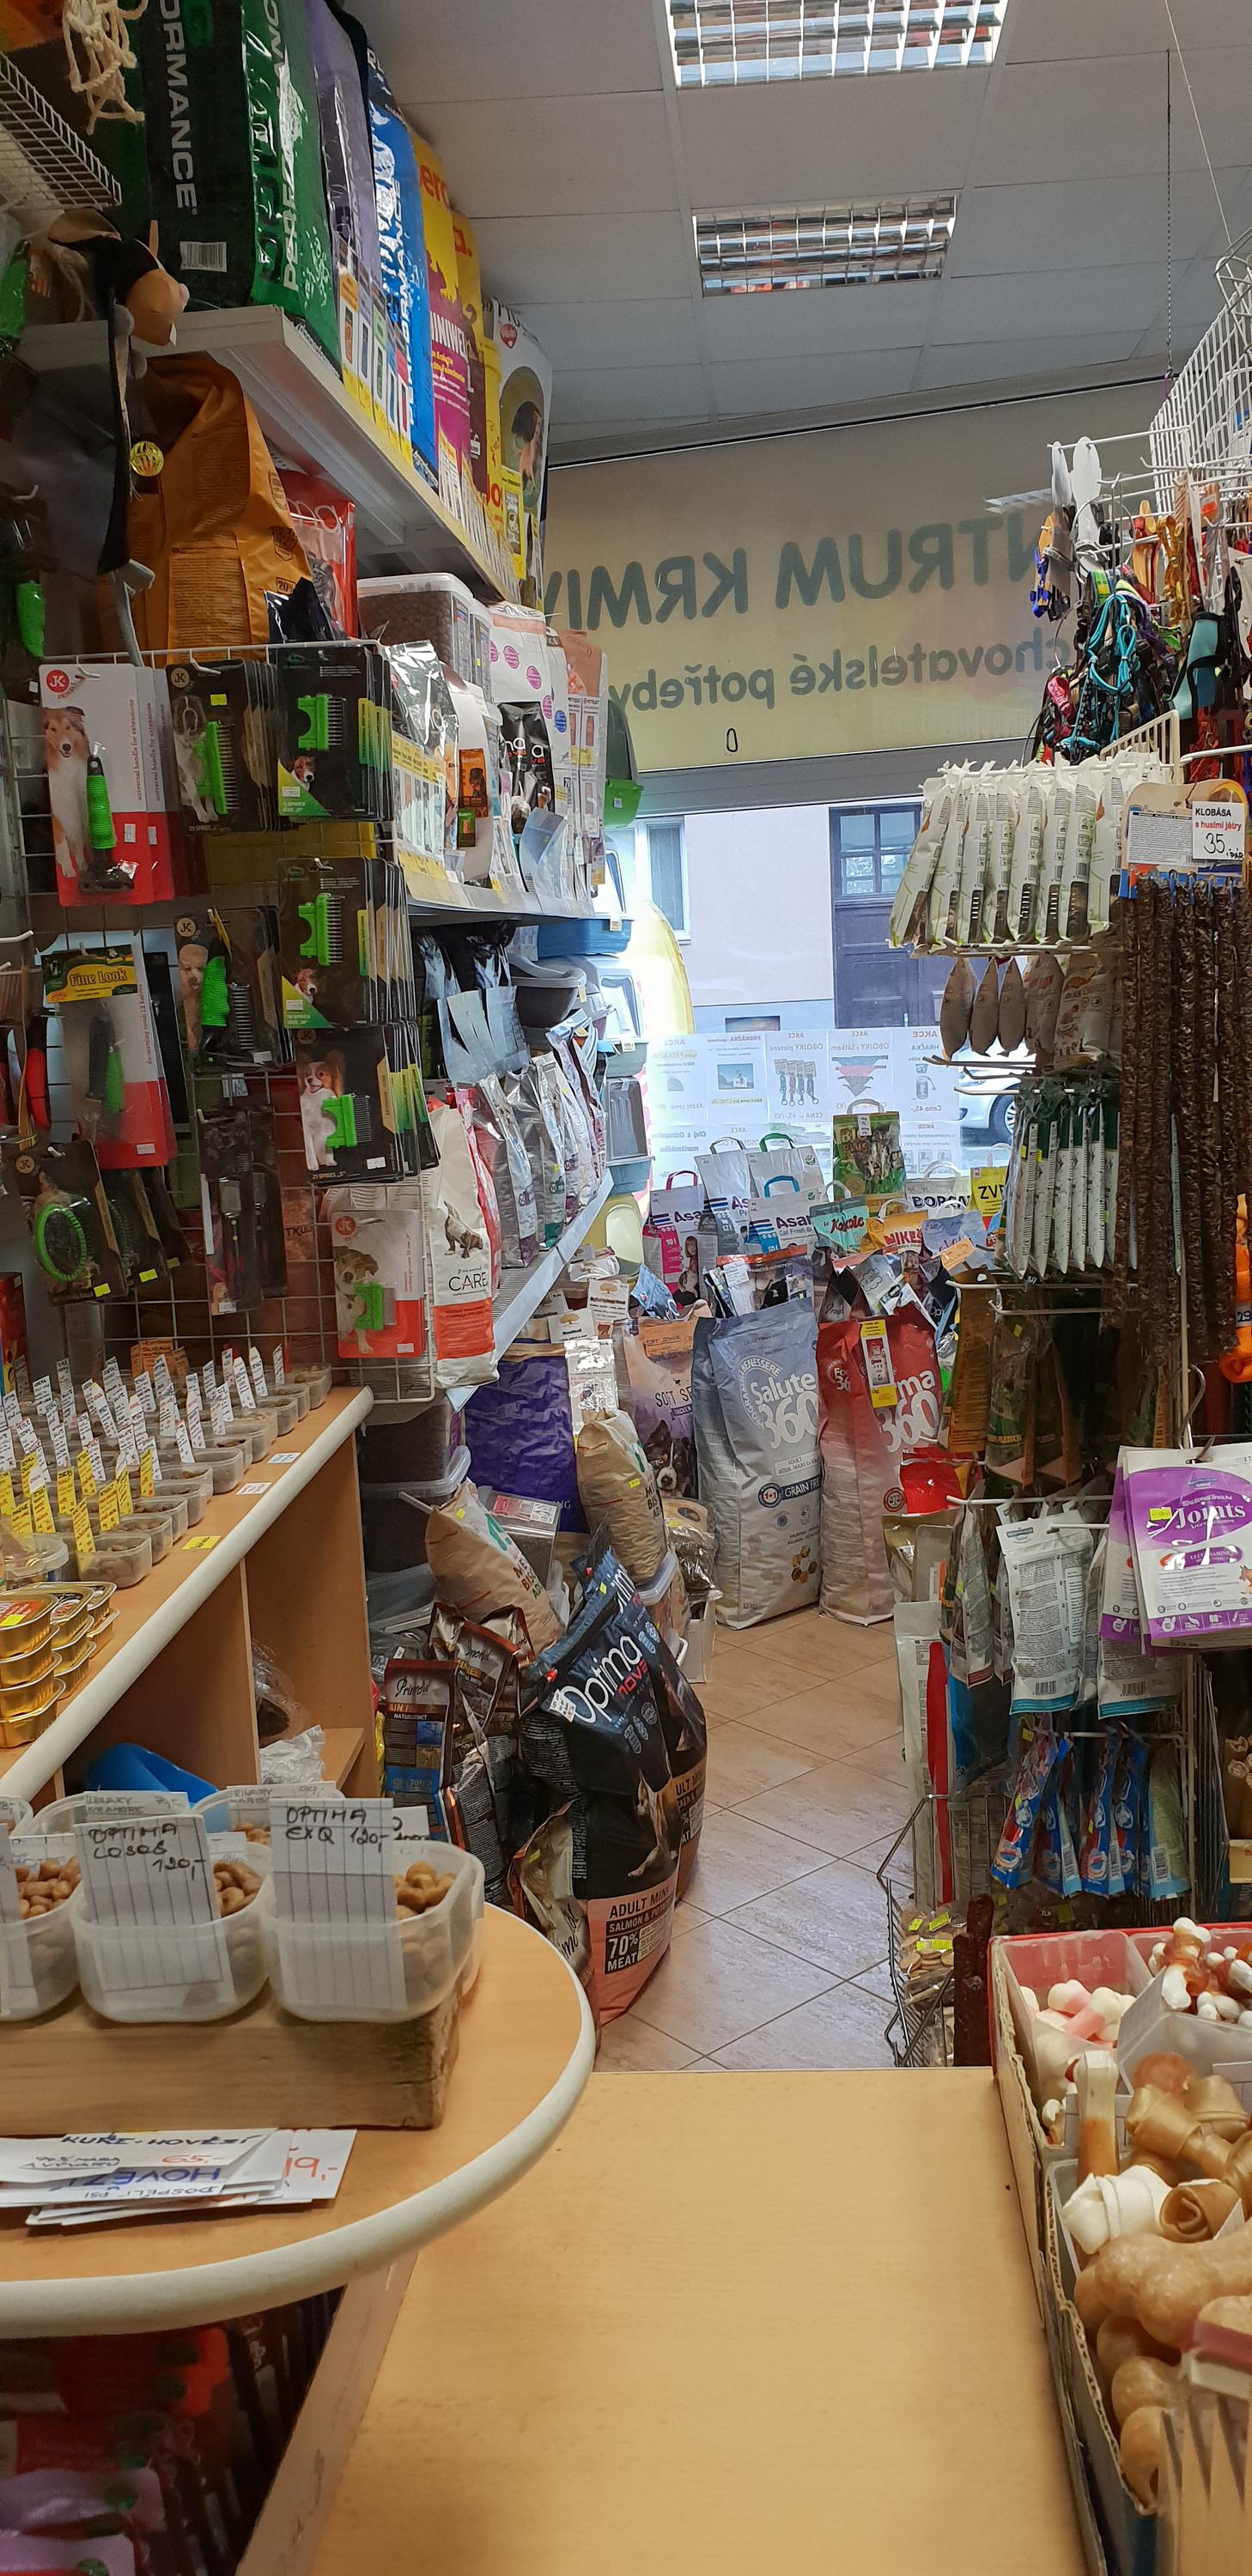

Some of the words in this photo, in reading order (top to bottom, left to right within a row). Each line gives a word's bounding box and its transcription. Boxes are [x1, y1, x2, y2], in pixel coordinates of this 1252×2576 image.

[50, 674, 66, 688] JK
[1194, 806, 1232, 817] KLOBÁSA
[70, 973, 96, 987] Fine
[97, 969, 127, 983] Look
[448, 1272, 488, 1291] CARE
[740, 1358, 782, 1377] BENESSERE
[750, 1373, 817, 1406] Salute
[757, 1390, 819, 1449] 360
[875, 1389, 941, 1454] 360
[784, 1480, 810, 1498] GRAIN
[1175, 1502, 1246, 1530] Joints
[558, 1635, 644, 1723] Optima
[617, 1659, 648, 1701] nova
[286, 1806, 367, 1825] OPTIMA
[87, 1823, 179, 1843] OPTIMA
[609, 1896, 648, 1919] ADULT
[609, 1913, 643, 1933] SALMON
[608, 1933, 639, 1959] 70%
[606, 1952, 638, 1972] MEAT
